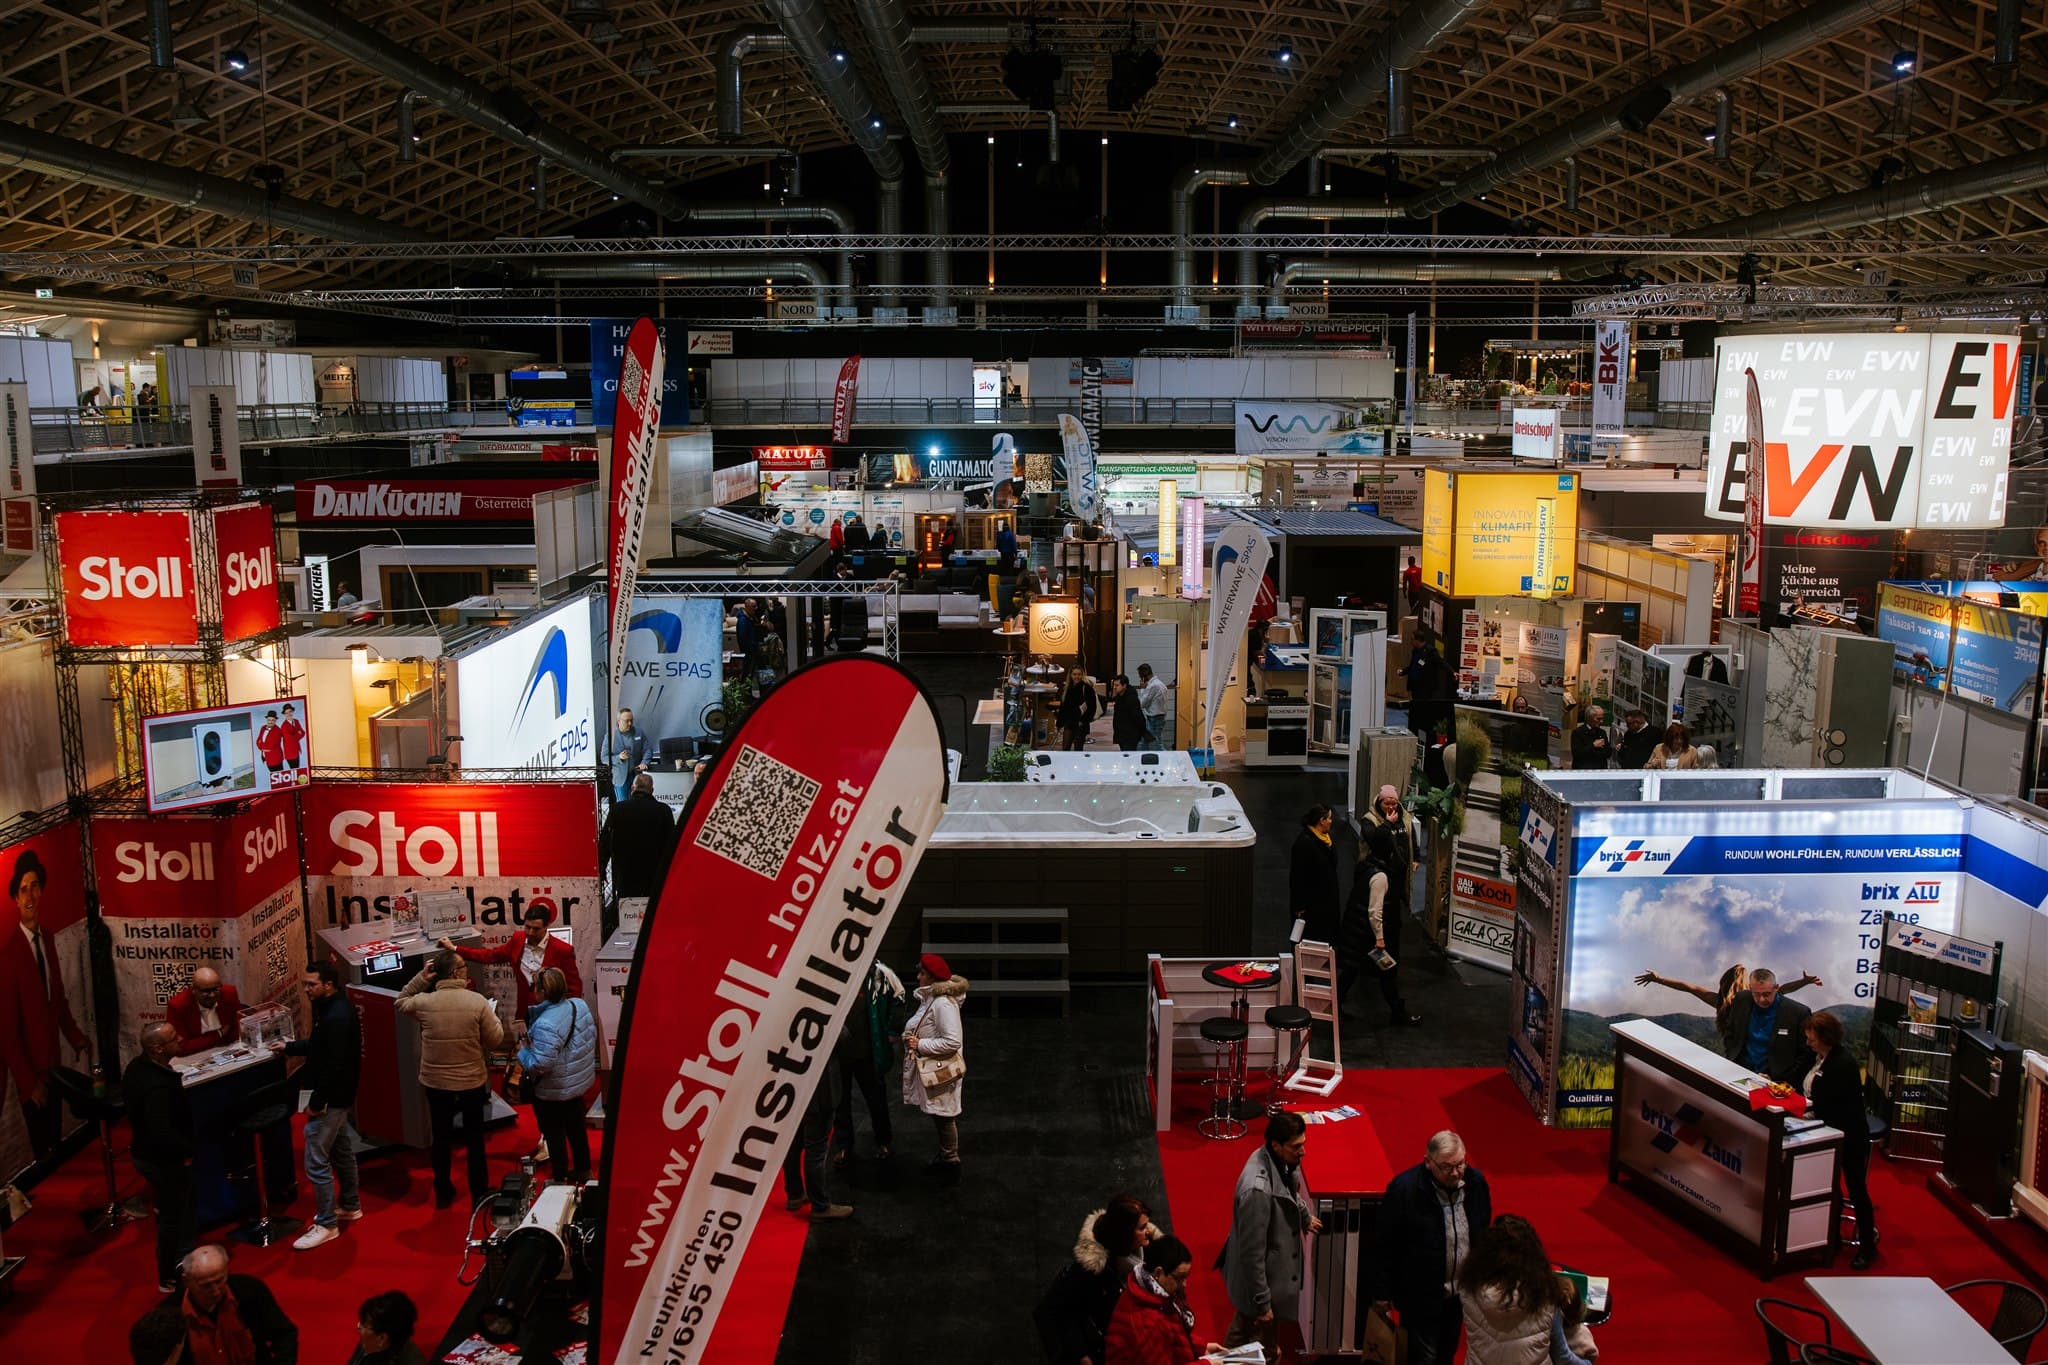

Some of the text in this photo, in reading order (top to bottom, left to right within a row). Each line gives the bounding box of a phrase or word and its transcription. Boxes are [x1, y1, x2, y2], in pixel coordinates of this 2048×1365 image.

[233, 269, 254, 285] WEST
[1870, 271, 1886, 286] OST
[781, 303, 814, 316] NORD
[1292, 305, 1325, 315] NORD
[1245, 324, 1380, 333] WITTMER STEINTEPPICH
[1781, 341, 1833, 363] EVN
[1598, 342, 1619, 384] BK
[1726, 351, 1759, 373] EVN
[1861, 351, 1920, 372] EVN
[1763, 369, 1788, 380] EVN
[1826, 369, 1856, 381] EVN
[978, 381, 995, 392] sky
[1725, 387, 1740, 399] EVN
[1761, 396, 1776, 408] VN
[834, 380, 850, 441] MATULA
[1781, 387, 1923, 438] EVN
[1514, 420, 1553, 442] Breitschopf
[1595, 423, 1620, 431] BETON
[478, 443, 532, 451] INFORMATION
[758, 448, 826, 459] MATULA
[1931, 436, 1976, 457] EVN
[1979, 455, 1995, 466] EVN
[1718, 441, 1913, 521] EVN
[1928, 474, 1954, 486] EVN
[1969, 483, 1988, 494] EVN
[1473, 510, 1534, 519] INNOVATIV
[1925, 503, 1971, 522] EVN
[1481, 522, 1532, 531] KLIMAFIT
[1472, 534, 1511, 543] BAUEN
[226, 546, 272, 596] Stoll
[1781, 564, 1816, 574] Meine
[79, 556, 184, 600] Stoll
[1781, 575, 1839, 585] Küche aus
[1216, 539, 1257, 635] WATERWAVE SPAS
[1780, 585, 1841, 597] Österreich
[1543, 632, 1559, 640] JIRA
[666, 660, 711, 679] SPAS
[560, 718, 589, 767] SPAS
[270, 770, 297, 785] Stoll
[244, 812, 288, 873] Stoll
[329, 810, 500, 877] Stoll
[1599, 850, 1671, 862] brix Zaun
[1725, 847, 1962, 860] RUNDUM WOHLFÜHLEN, RUNDUM VERLÄSSLICH.
[115, 841, 215, 883] Stoll
[1475, 882, 1512, 905] Koch
[1861, 883, 1940, 900] brix ALU
[252, 889, 294, 928] Installatör
[124, 922, 219, 939] Installatör
[248, 906, 301, 953] NEUNKIRCHEN
[1454, 920, 1485, 939] GALA
[116, 945, 234, 961] NEUNKIRCHEN
[710, 805, 918, 1196] Installatör
[1568, 1094, 1601, 1103] Qualität
[1642, 1100, 1741, 1175] brix Zaun
[703, 1209, 743, 1275] 450
[639, 1208, 716, 1357] Neunkirchen
